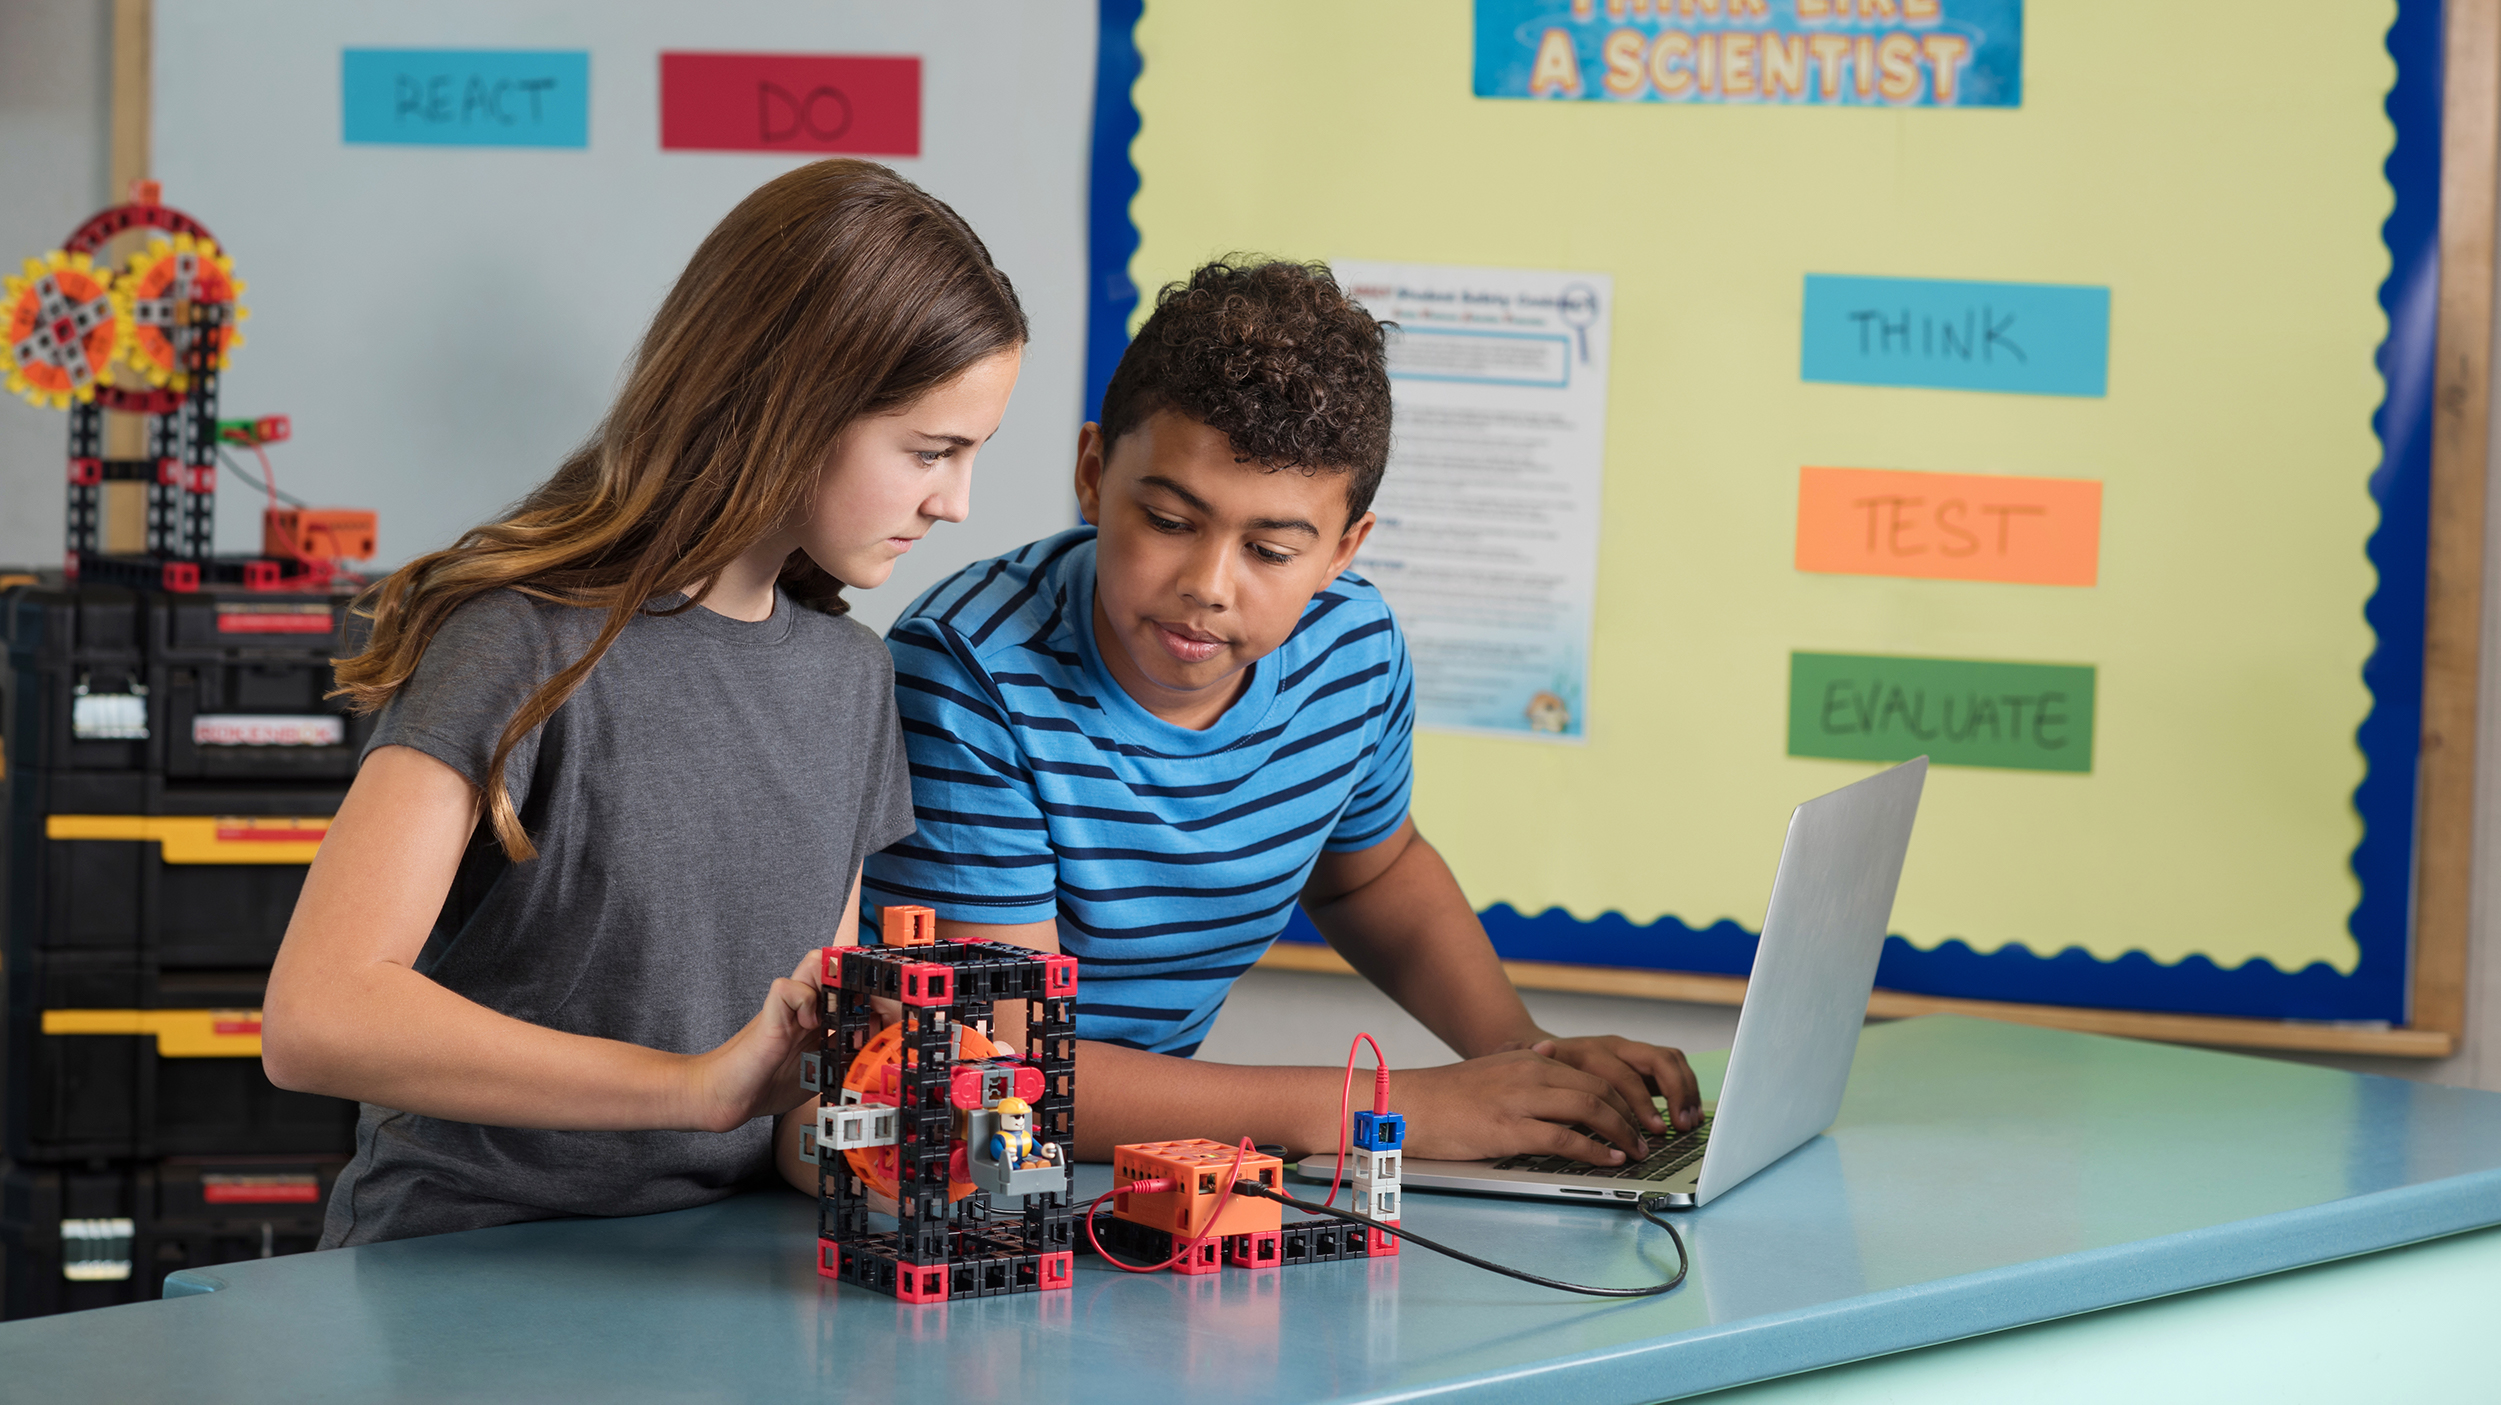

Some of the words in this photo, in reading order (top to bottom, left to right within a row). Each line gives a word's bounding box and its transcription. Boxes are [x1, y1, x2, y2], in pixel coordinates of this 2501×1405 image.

[1529, 27, 1581, 95] A
[1603, 28, 1972, 101] SCIENTIST
[392, 72, 558, 126] REACT
[757, 80, 854, 143] DO
[1847, 303, 2028, 366] THINK
[1853, 494, 2046, 559] TEST
[1820, 678, 2068, 751] EVALUATE
